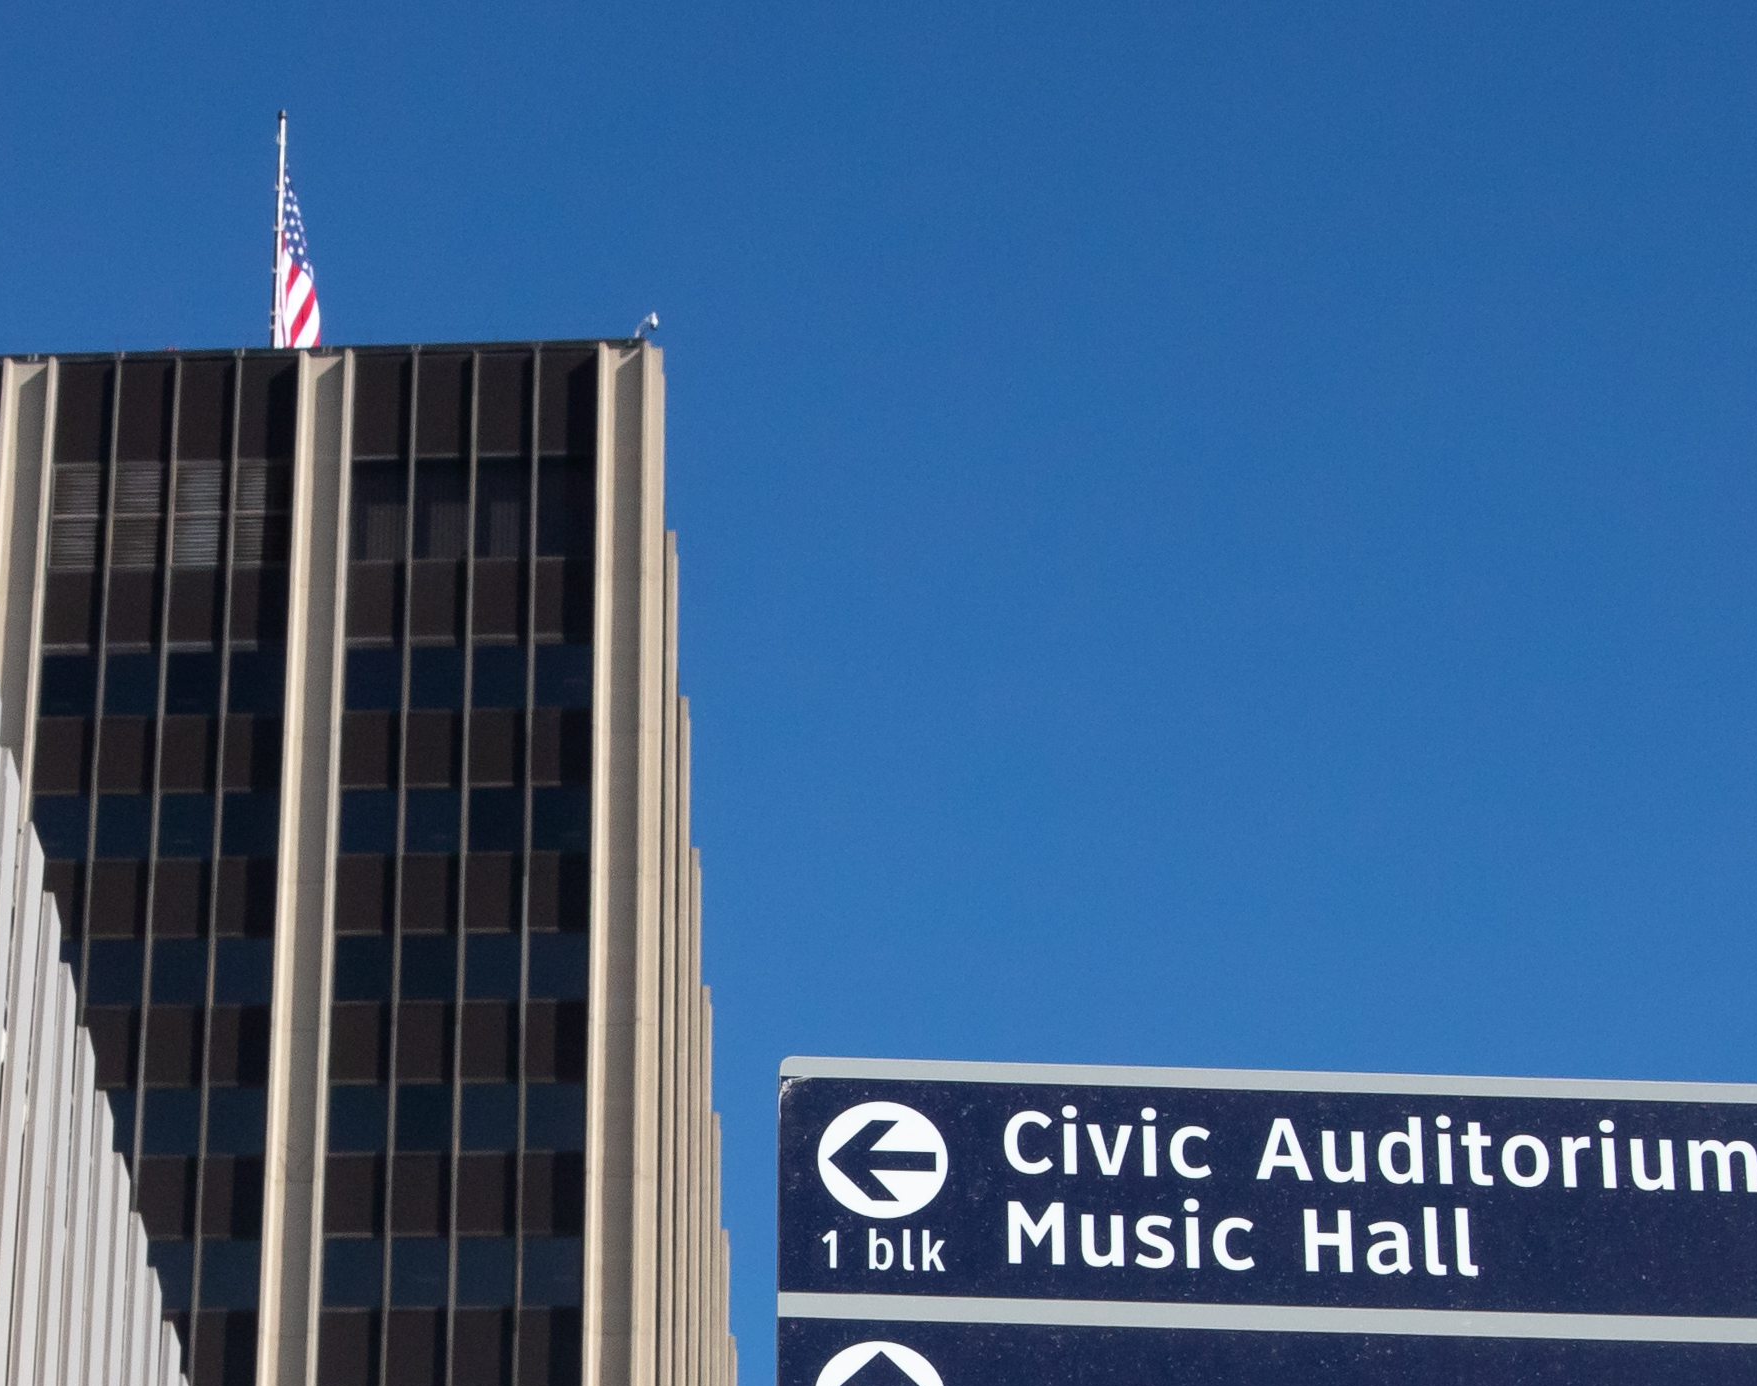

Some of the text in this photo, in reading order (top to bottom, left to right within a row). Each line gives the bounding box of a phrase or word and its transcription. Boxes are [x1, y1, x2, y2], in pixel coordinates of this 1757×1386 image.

[1003, 1104, 1212, 1179] Civic
[821, 1227, 946, 1272] 1 blk
[1007, 1198, 1479, 1277] Music Hall
